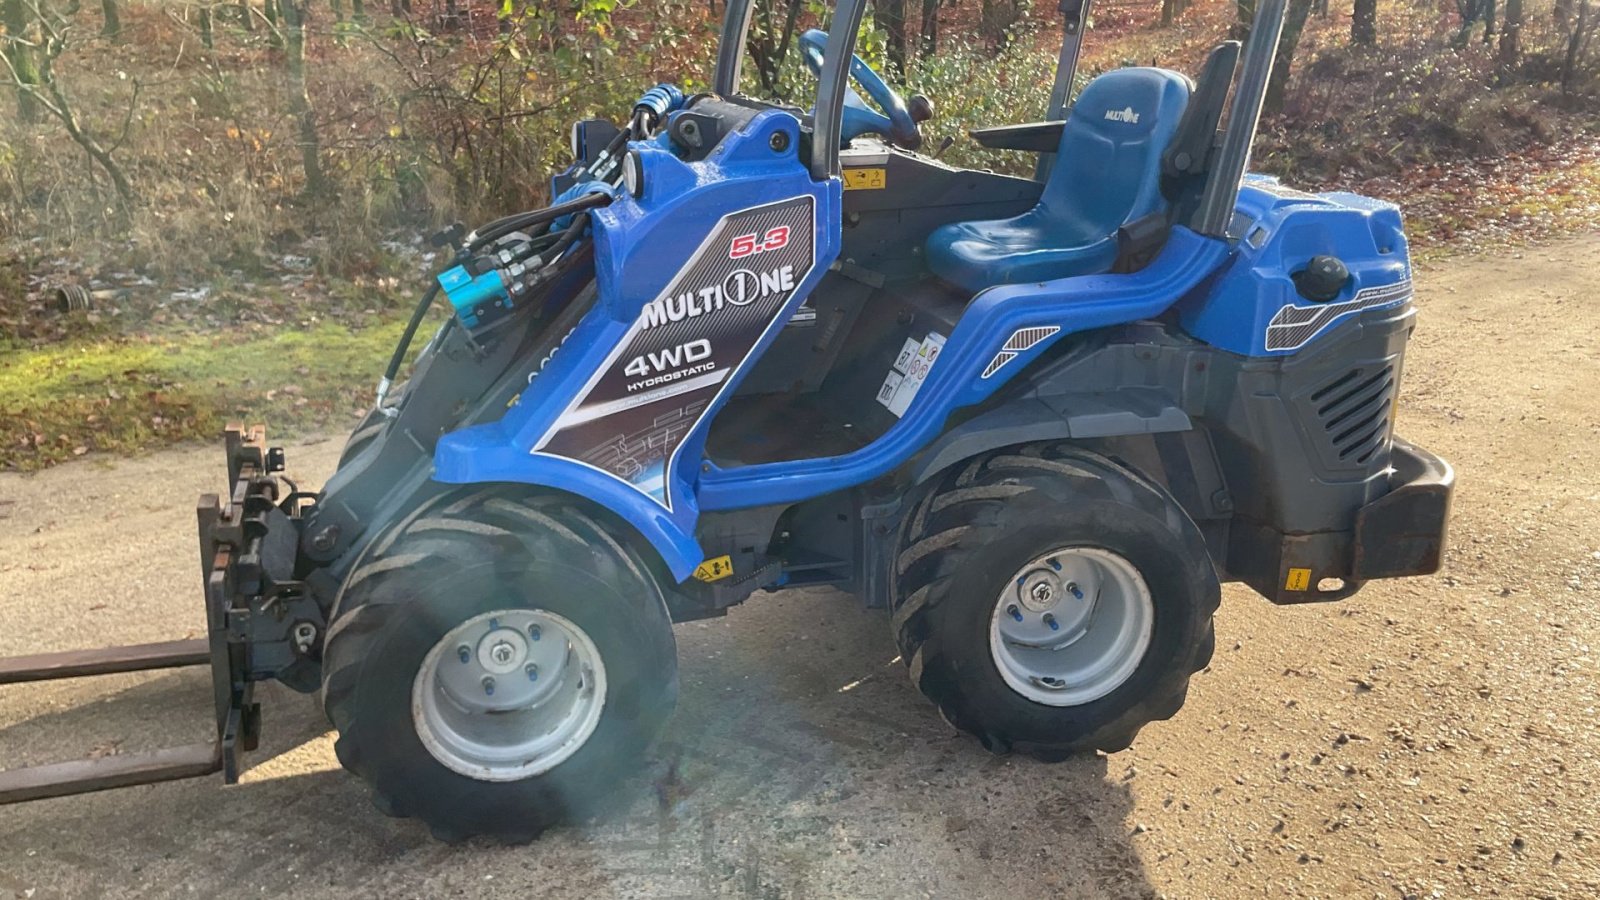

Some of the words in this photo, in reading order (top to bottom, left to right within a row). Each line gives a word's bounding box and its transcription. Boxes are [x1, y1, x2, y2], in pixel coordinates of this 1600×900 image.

[729, 225, 790, 259] 5.3
[624, 338, 712, 377] 4WD
[627, 361, 716, 392] HYDROSTATIC
